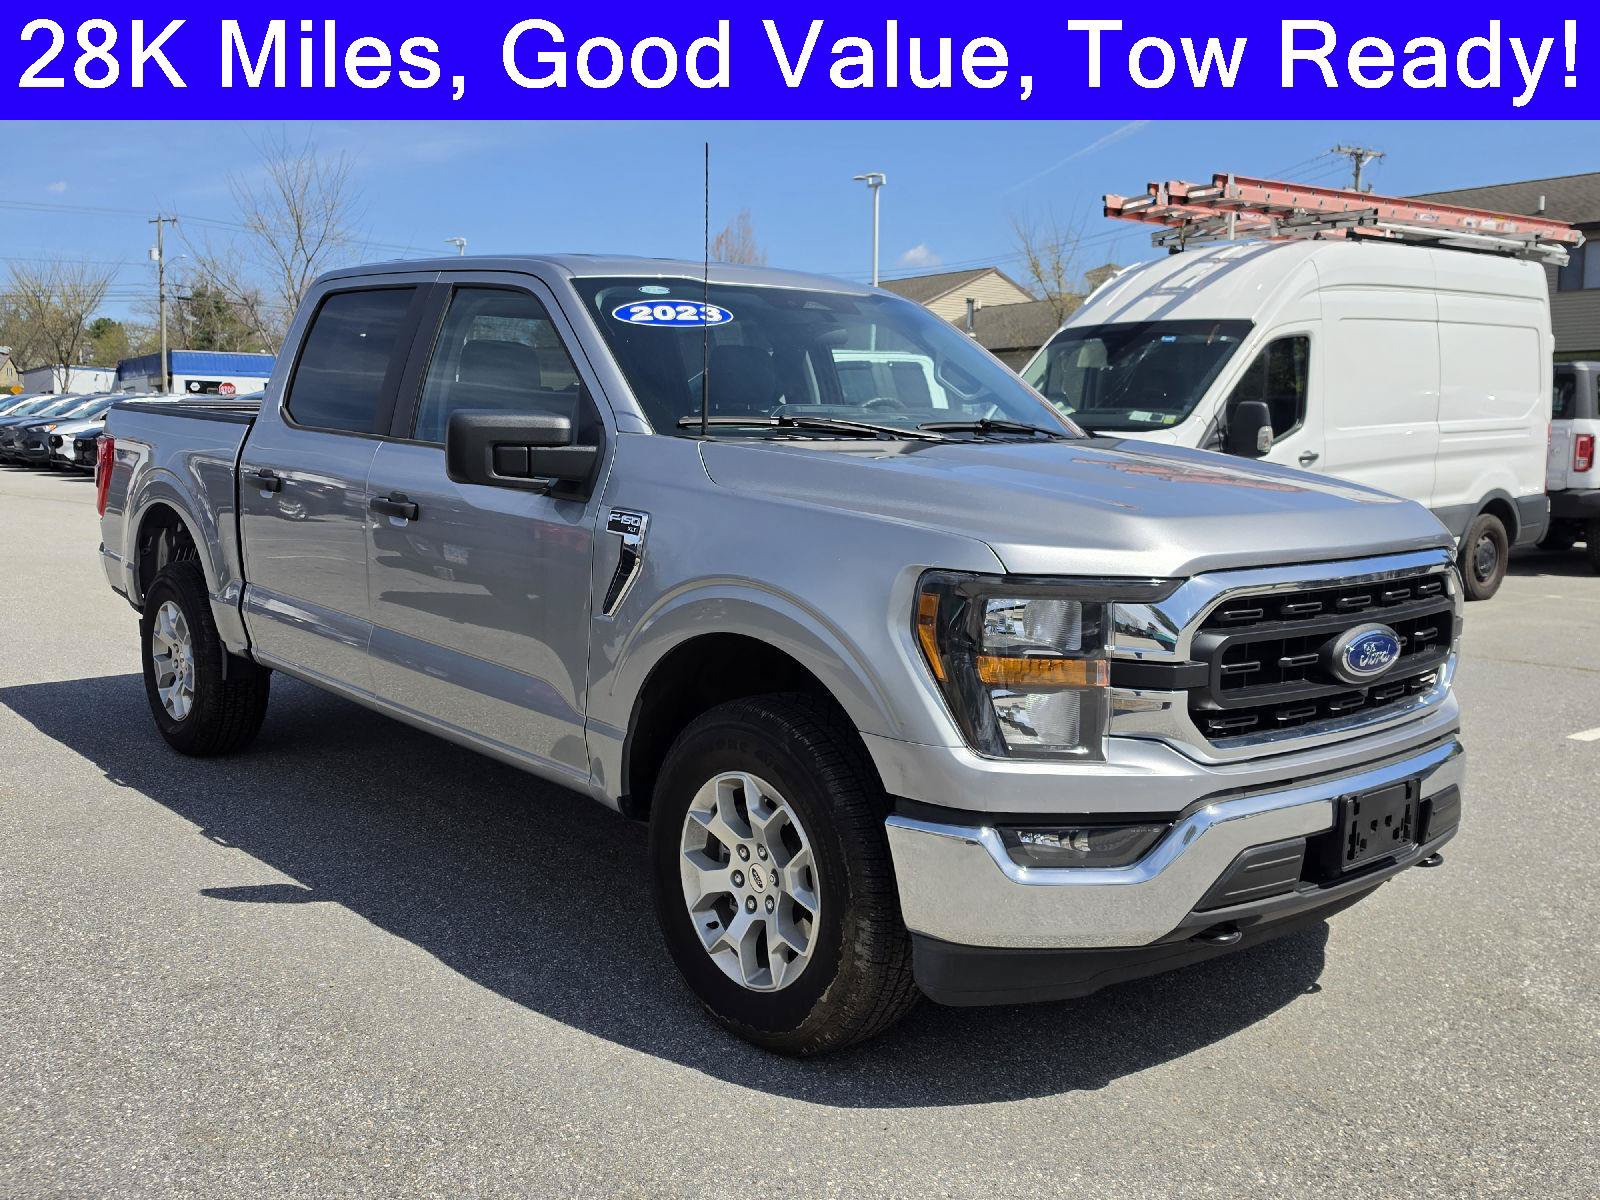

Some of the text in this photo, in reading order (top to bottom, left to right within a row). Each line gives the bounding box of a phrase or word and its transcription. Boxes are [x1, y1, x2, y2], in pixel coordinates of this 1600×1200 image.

[629, 305, 722, 321] 2023
[220, 385, 235, 394] STOP
[609, 513, 641, 526] F-150
[1359, 641, 1391, 667] Ford
